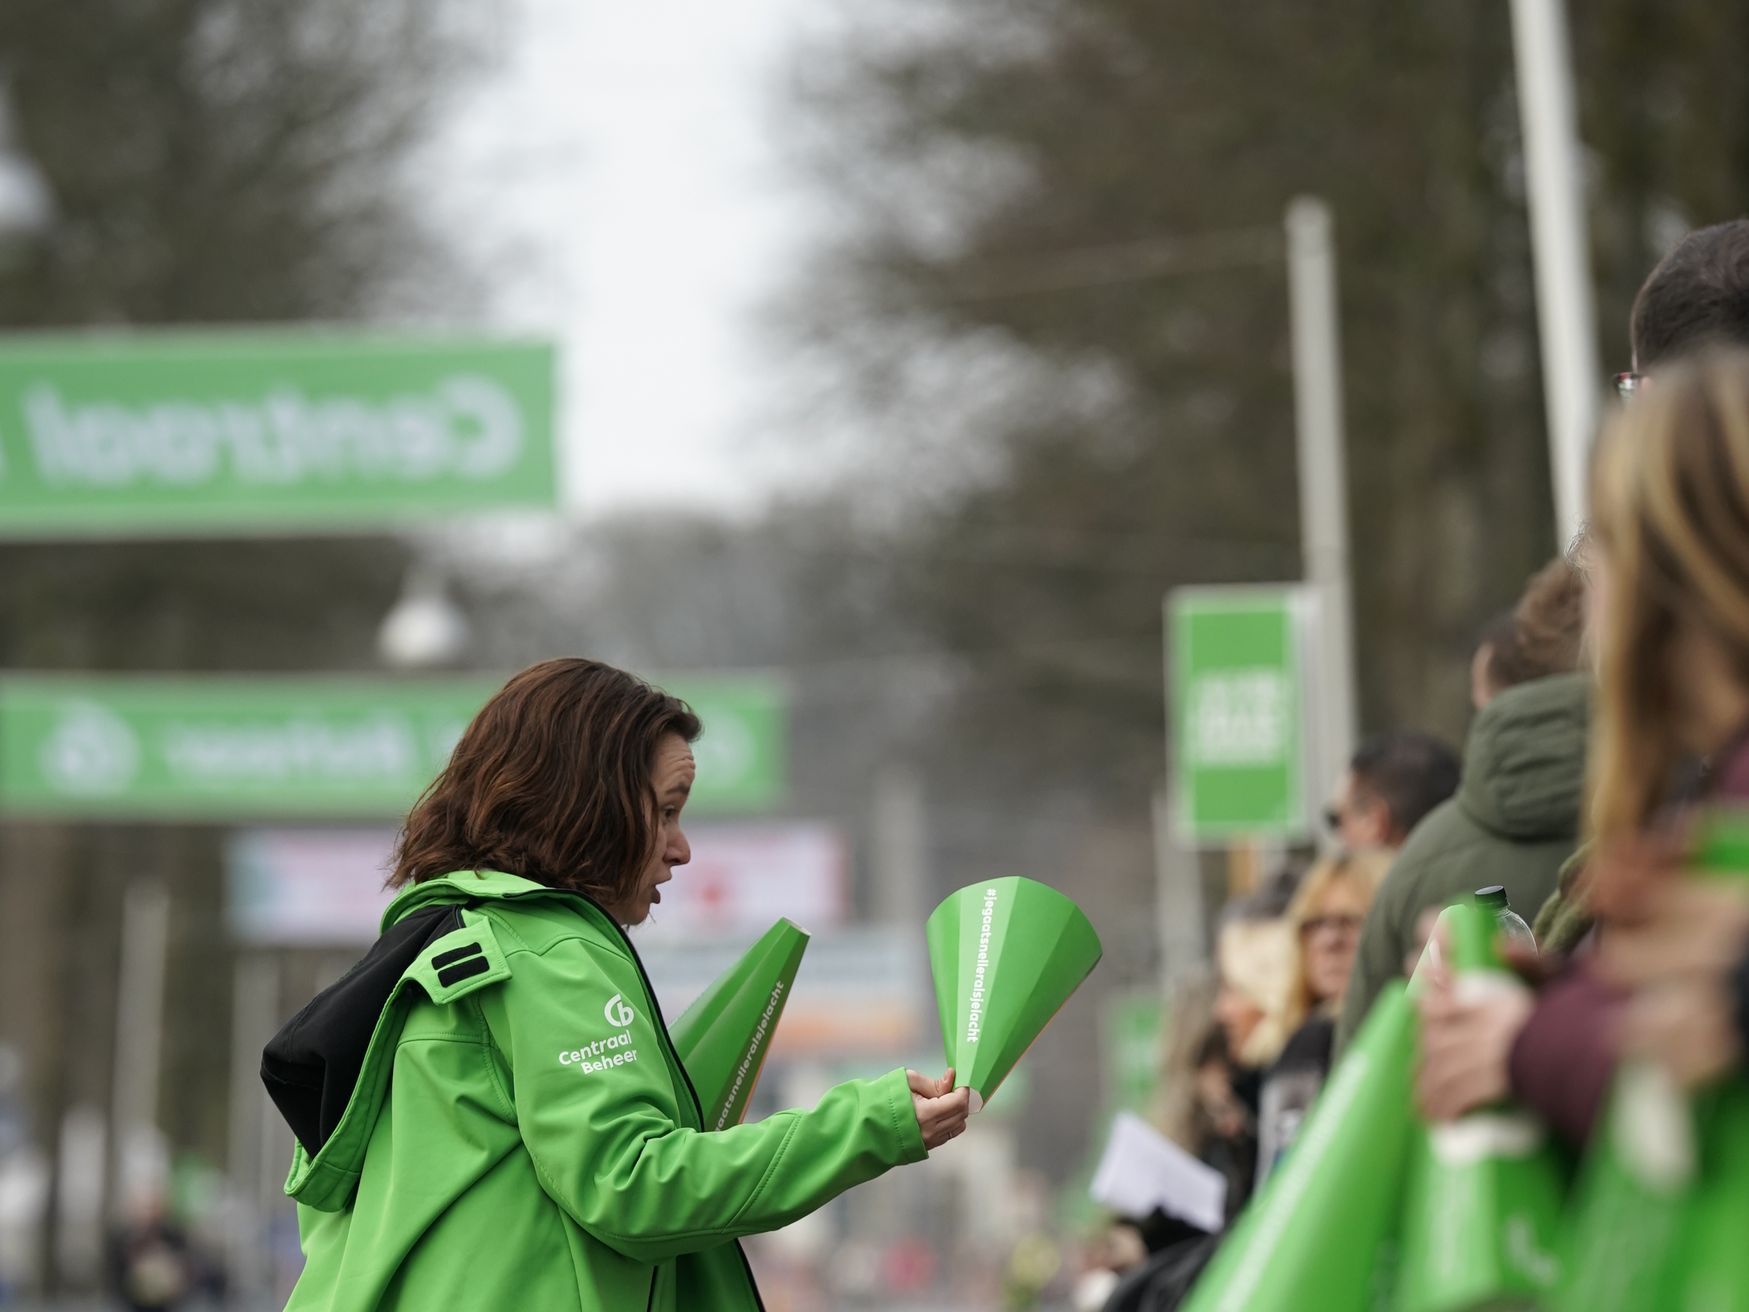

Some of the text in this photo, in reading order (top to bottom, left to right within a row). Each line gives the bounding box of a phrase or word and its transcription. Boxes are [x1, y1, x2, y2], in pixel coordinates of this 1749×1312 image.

[966, 888, 997, 1044] #jegaatsnelleralsjelacht
[558, 1029, 632, 1065] Centraal
[581, 1049, 637, 1075] Beheer
